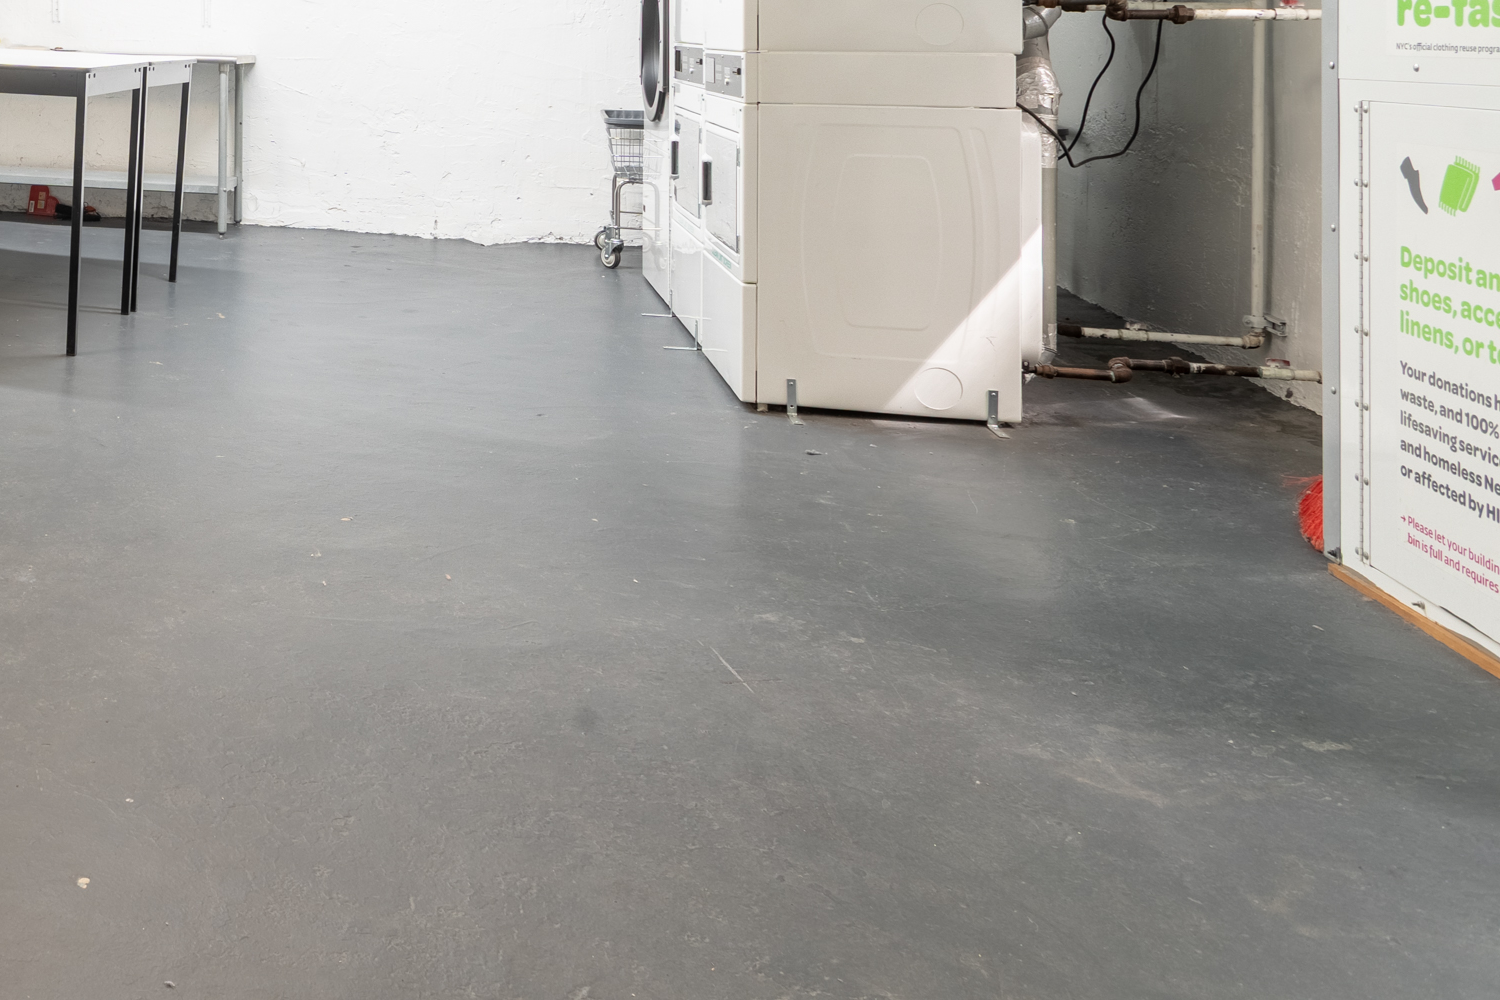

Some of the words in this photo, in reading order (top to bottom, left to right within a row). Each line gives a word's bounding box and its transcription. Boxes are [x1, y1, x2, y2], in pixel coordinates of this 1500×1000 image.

[1413, 43, 1432, 51] official
[1433, 43, 1458, 53] clothing
[1401, 246, 1473, 285] Deposit
[1400, 279, 1457, 319] shoes,
[1400, 310, 1459, 354] linens,
[1462, 337, 1484, 358] or
[1400, 360, 1426, 382] Your
[1428, 372, 1492, 408] donations
[1400, 389, 1437, 416] waste,
[1439, 405, 1462, 424] and
[1465, 412, 1499, 439] 100%
[1400, 410, 1457, 453] lifesaving
[1459, 438, 1500, 467] servic
[1400, 440, 1421, 458] and
[1424, 446, 1482, 487] homeless
[1400, 465, 1412, 479] or
[1414, 471, 1466, 507] affected
[1468, 493, 1484, 518] by
[1408, 515, 1433, 538] Please
[1434, 529, 1446, 545] let
[1447, 538, 1467, 556] your
[1408, 532, 1420, 549] bin
[1422, 540, 1428, 553] is
[1429, 545, 1442, 562] full
[1444, 556, 1460, 571] and
[1462, 565, 1499, 593] requires
